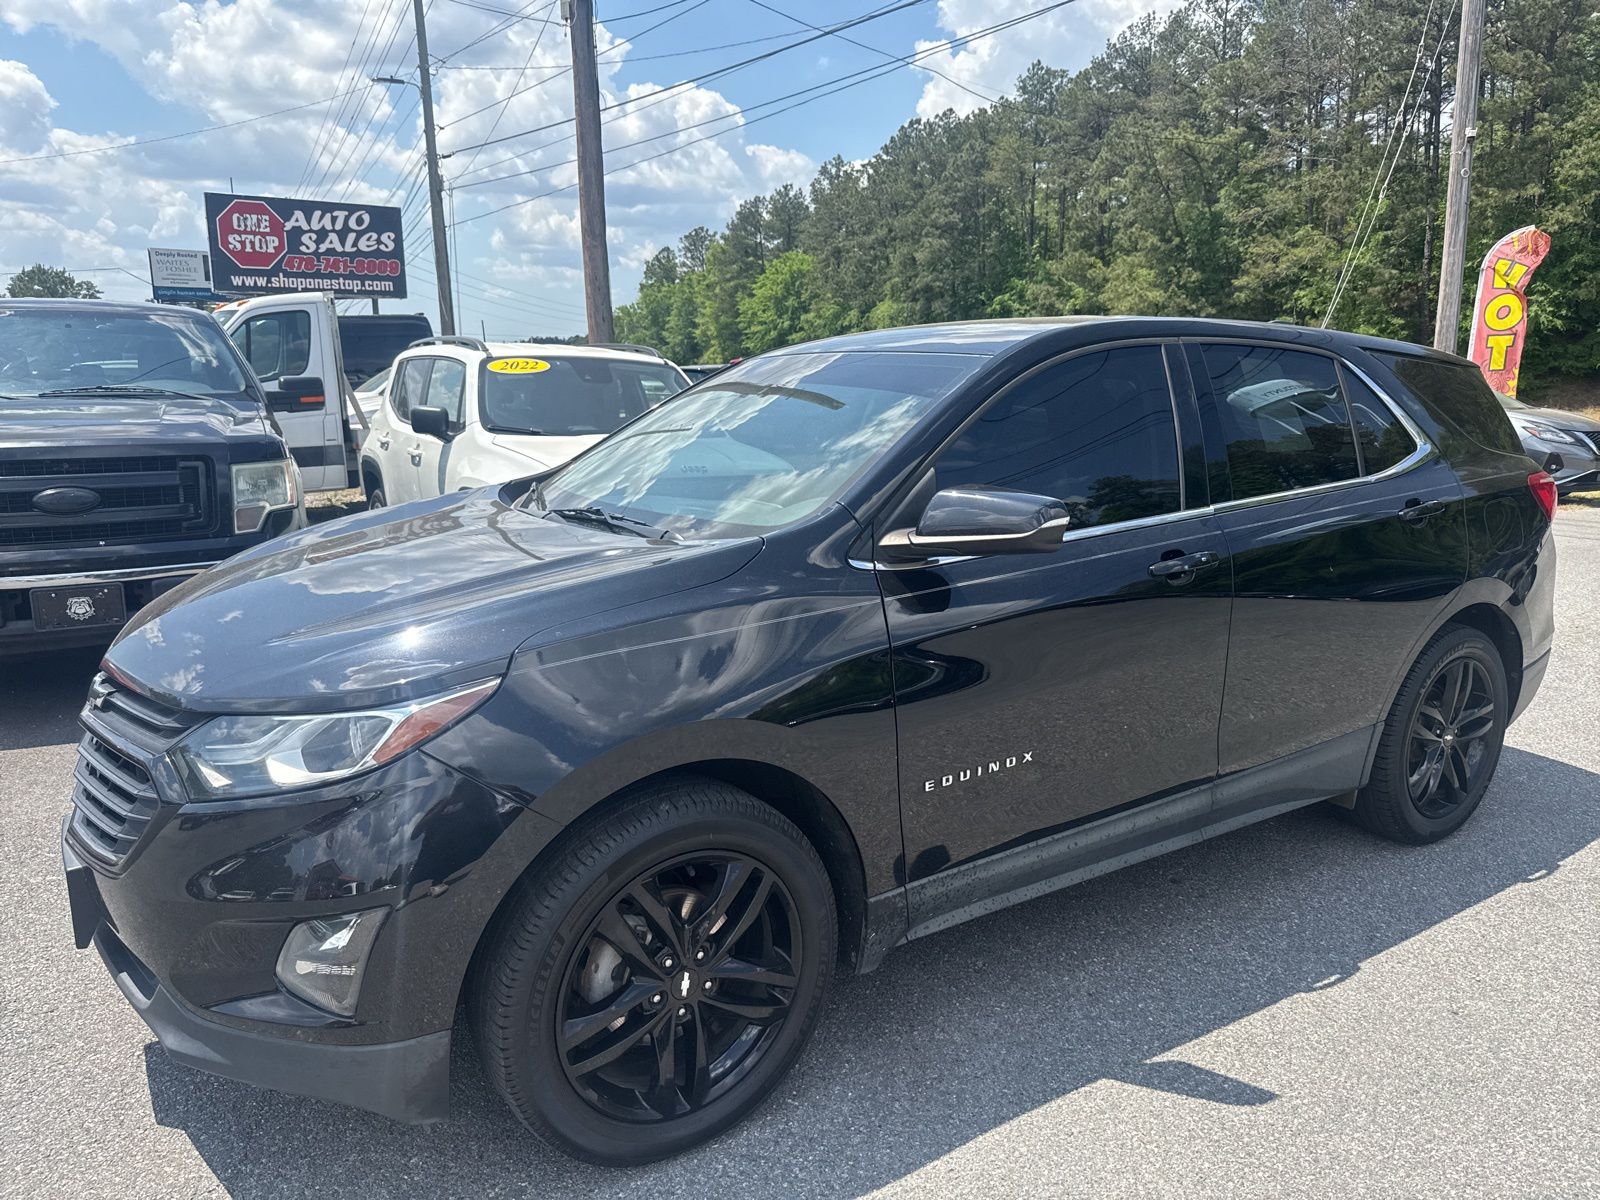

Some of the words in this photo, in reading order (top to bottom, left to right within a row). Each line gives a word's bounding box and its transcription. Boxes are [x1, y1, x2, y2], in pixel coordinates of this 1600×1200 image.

[232, 213, 270, 232] ONE
[284, 210, 370, 231] AUTO
[228, 233, 279, 253] STOP
[231, 272, 394, 293] www.shoponestop.com
[1484, 257, 1529, 371] HOT
[500, 361, 539, 371] 2022
[924, 751, 1033, 792] EQUINOX
[528, 938, 563, 1047] MICHELIN
